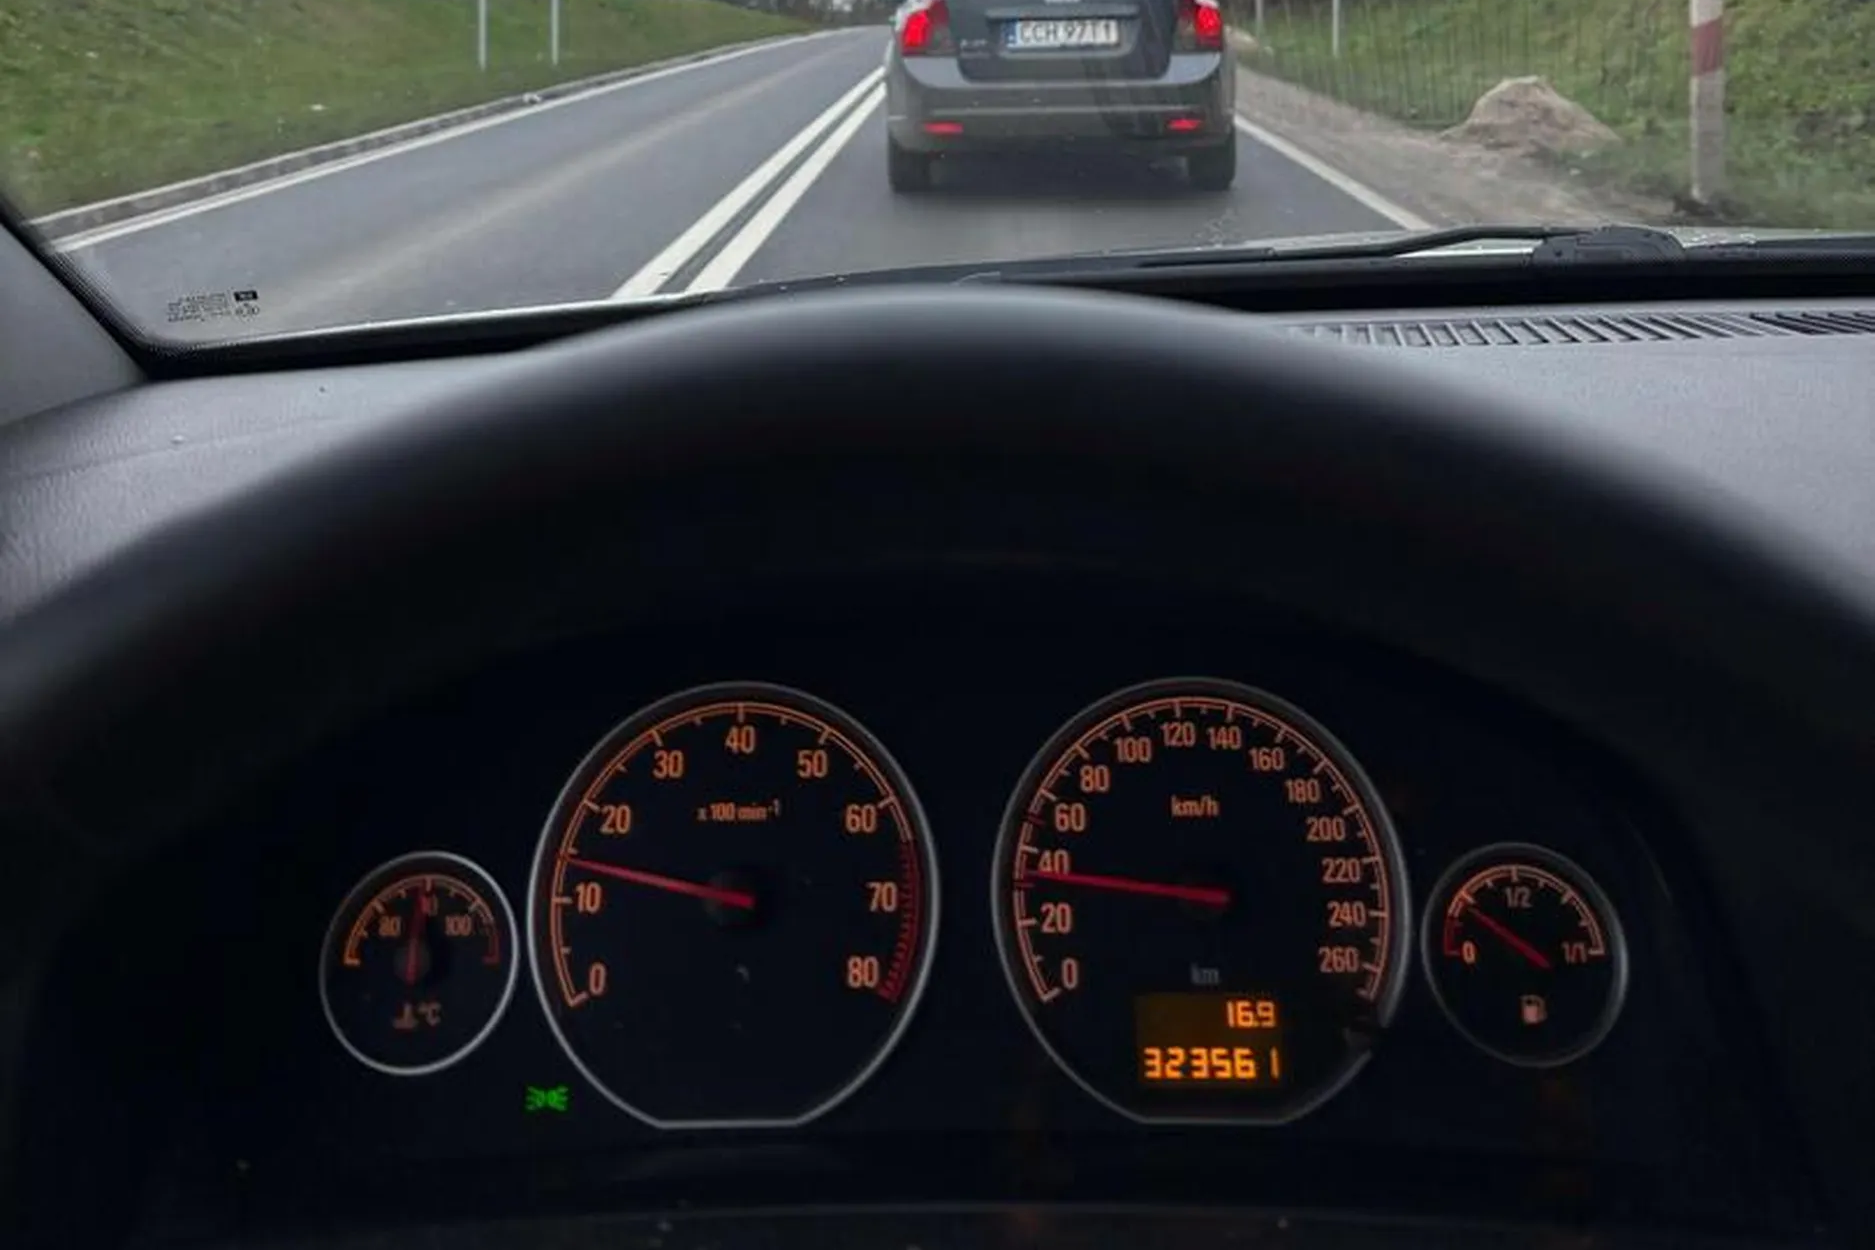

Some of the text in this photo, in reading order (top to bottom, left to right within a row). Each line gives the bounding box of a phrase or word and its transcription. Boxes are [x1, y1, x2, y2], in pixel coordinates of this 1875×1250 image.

[725, 725, 756, 753] 40
[1162, 722, 1196, 747] 120
[1208, 726, 1242, 750] 140
[1116, 737, 1152, 763] 100
[1249, 747, 1285, 771] 160
[653, 750, 684, 778] 30
[797, 750, 828, 778] 50
[1080, 765, 1111, 792] 80
[1286, 778, 1320, 803] 180
[600, 804, 632, 834] 20
[710, 802, 736, 822] 100
[845, 803, 877, 833] 60
[1054, 802, 1087, 831] 60
[1171, 795, 1220, 817] km/h
[1306, 816, 1346, 841] 200
[1322, 858, 1361, 883] 220
[575, 882, 602, 913] 10
[868, 881, 898, 912] 70
[445, 914, 473, 936] 100
[1041, 903, 1072, 933] 20
[1328, 901, 1366, 927] 240
[1319, 946, 1359, 973] 260
[1463, 940, 1476, 964] 0
[589, 963, 606, 995] 0
[848, 957, 879, 988] 80
[1062, 958, 1079, 989] 0
[1190, 963, 1220, 985] km
[1144, 1046, 1279, 1079] 323561
